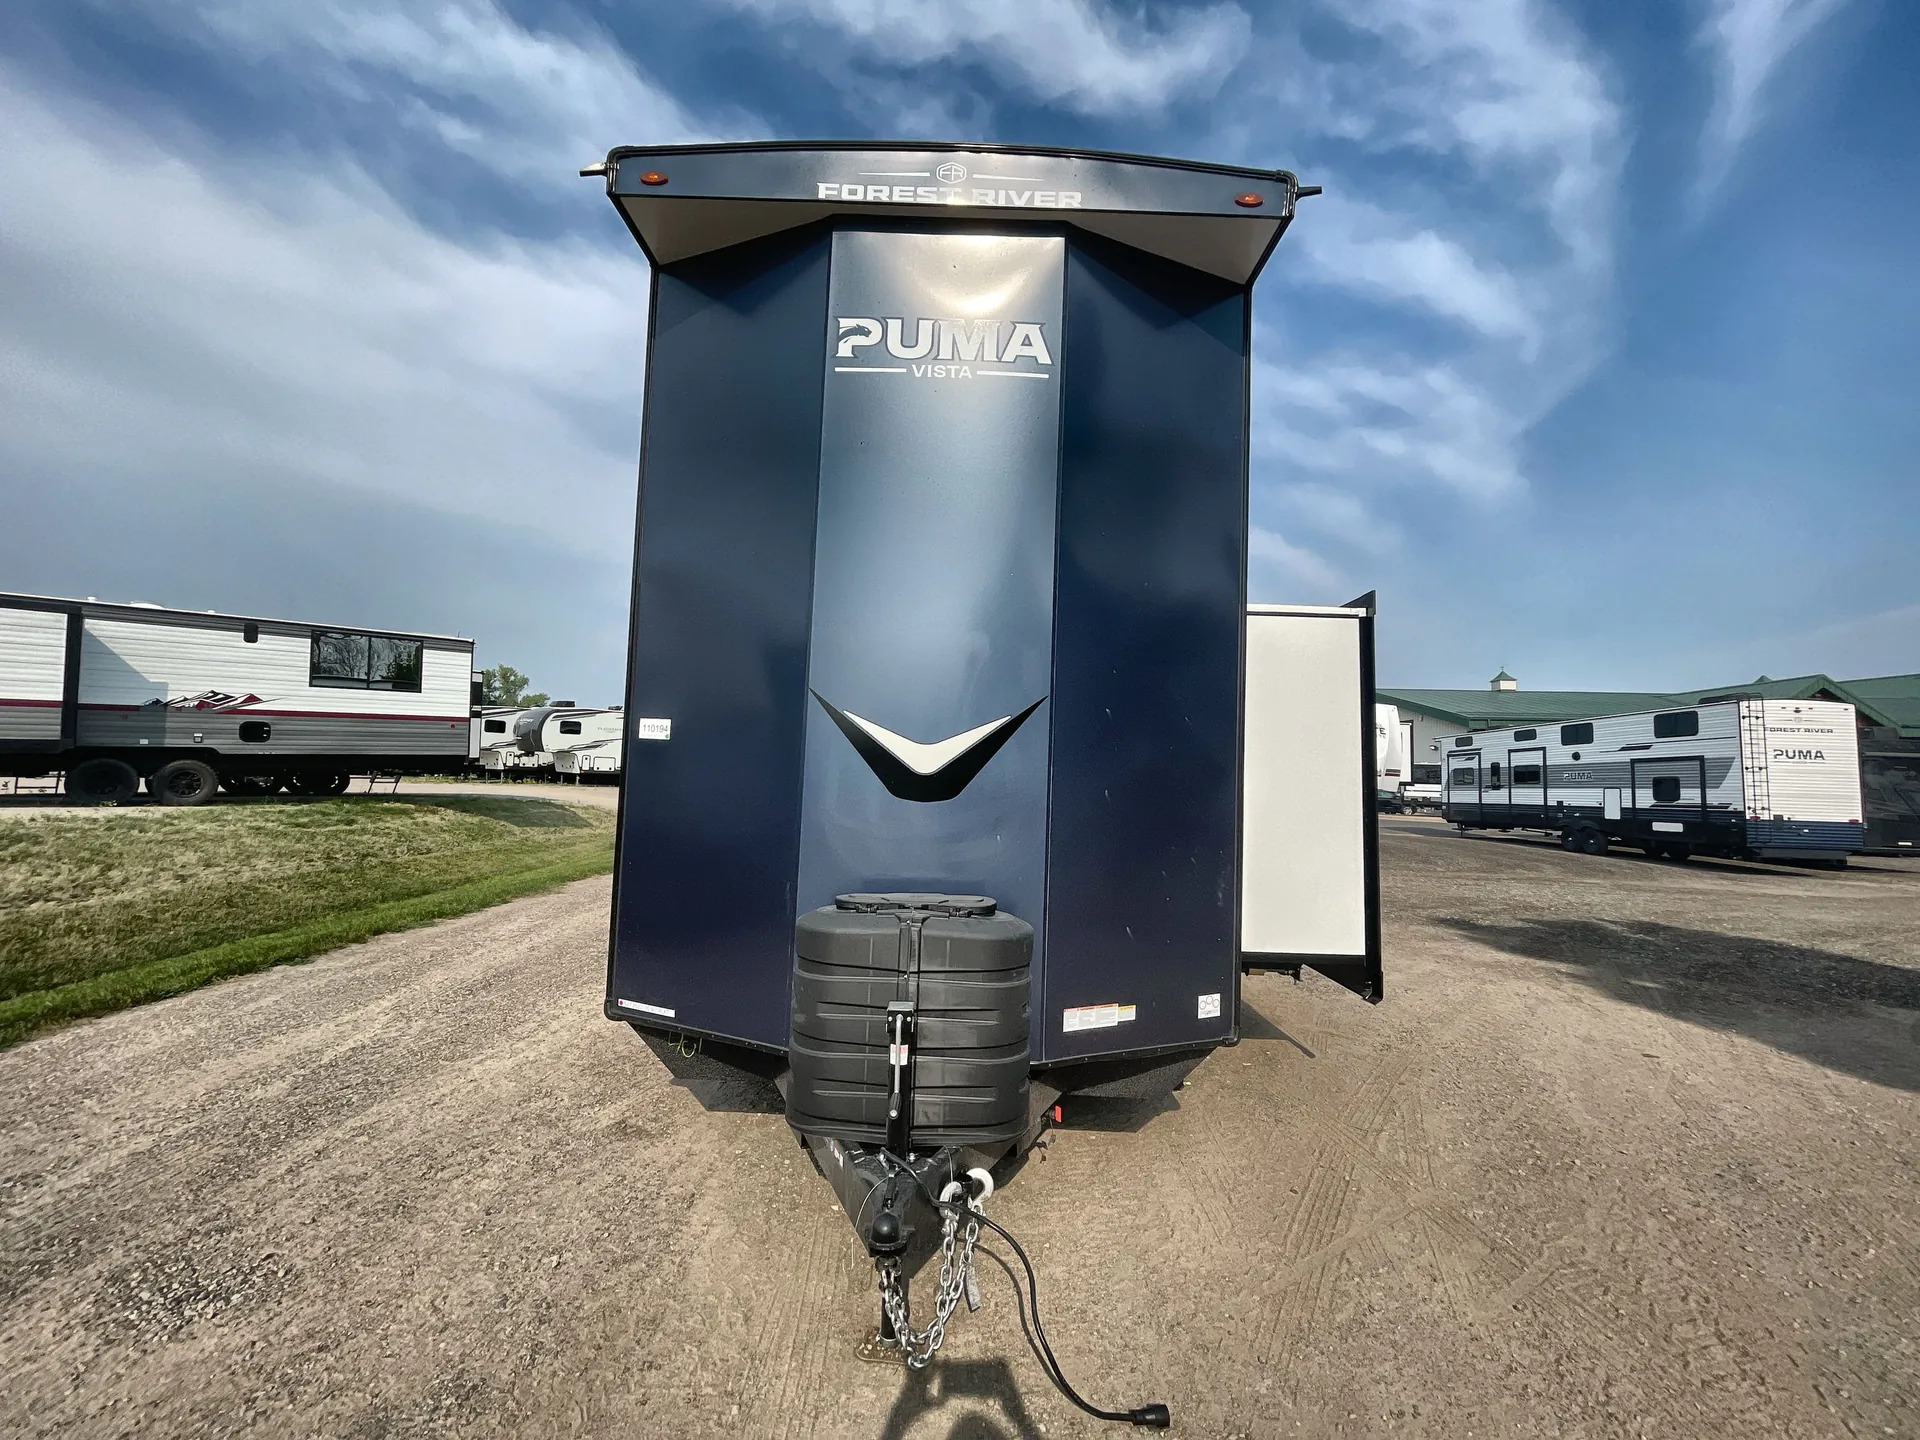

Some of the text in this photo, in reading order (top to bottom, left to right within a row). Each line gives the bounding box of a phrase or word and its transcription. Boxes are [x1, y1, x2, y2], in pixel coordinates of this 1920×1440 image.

[816, 181, 1083, 208] FOREST RIVER
[834, 317, 1053, 365] PUMA
[911, 364, 973, 379] VISTA
[642, 724, 669, 733] 110194
[1773, 749, 1825, 760] PUMA
[1563, 771, 1593, 781] PUMA
